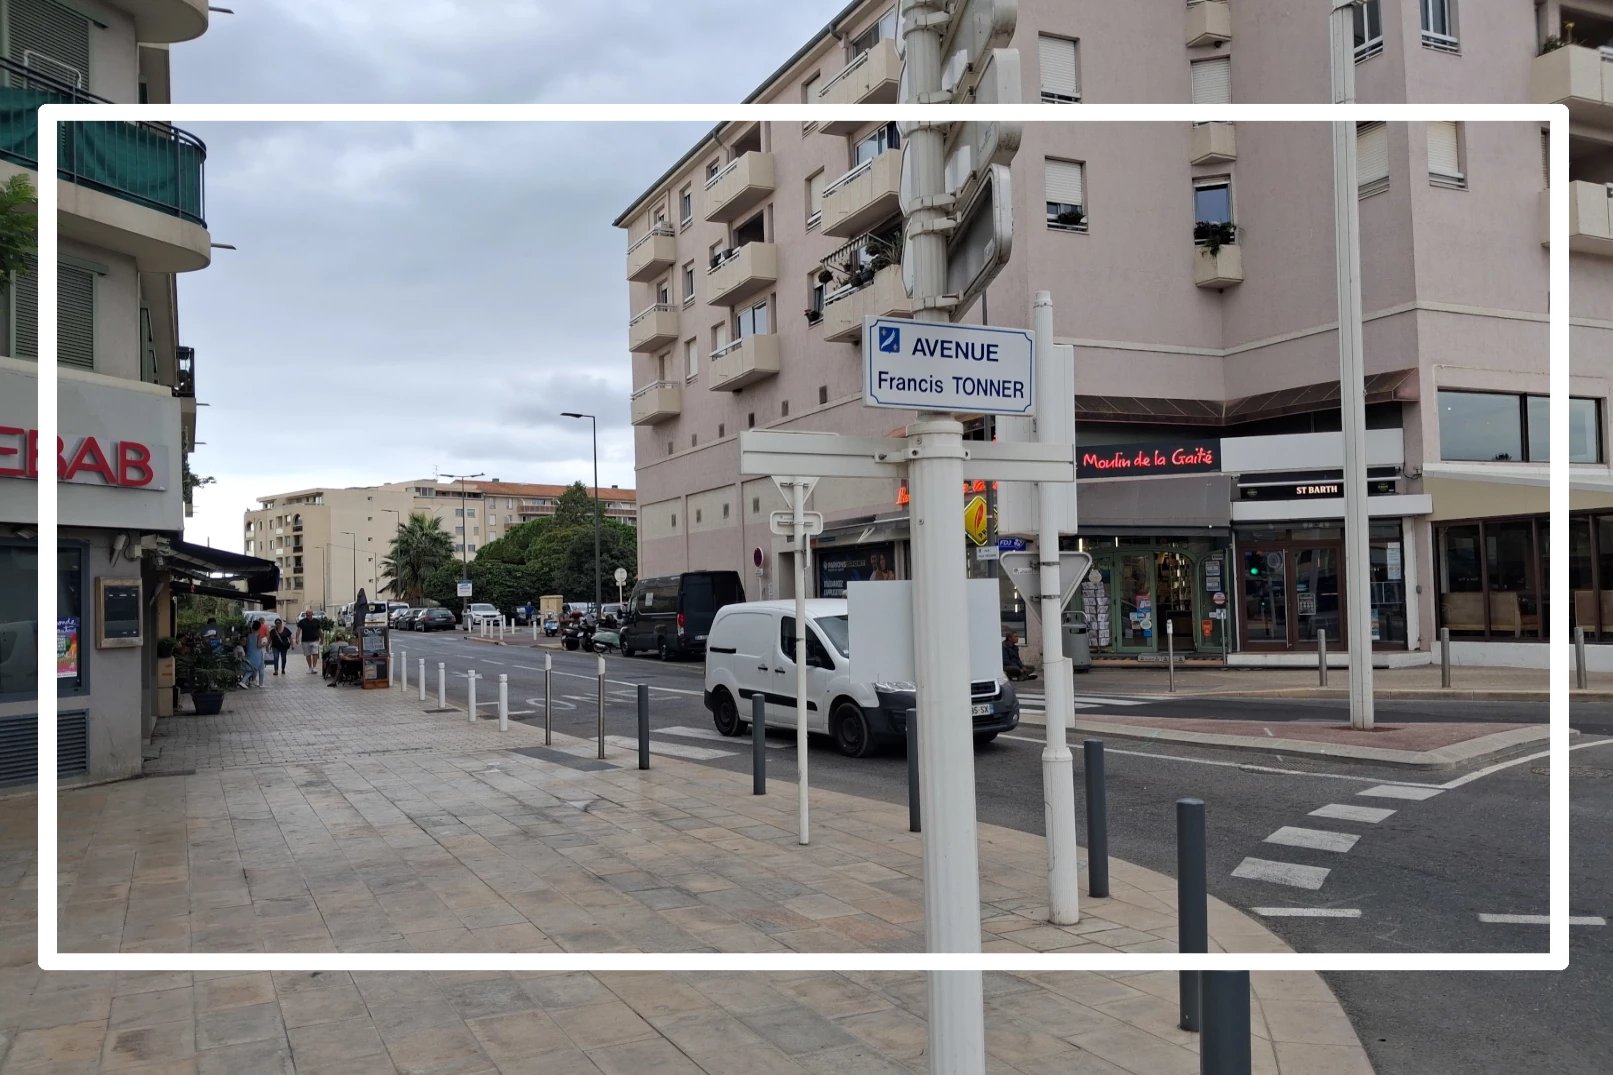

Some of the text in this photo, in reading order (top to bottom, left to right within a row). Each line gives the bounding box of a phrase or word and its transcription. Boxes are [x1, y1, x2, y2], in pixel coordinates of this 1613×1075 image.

[912, 337, 999, 362] AVENUE
[878, 371, 1024, 399] Francis TONNER
[1083, 452, 1131, 469] Moulin
[1134, 450, 1151, 466] de
[1154, 450, 1166, 466] la
[1296, 485, 1338, 495] ST BARTH
